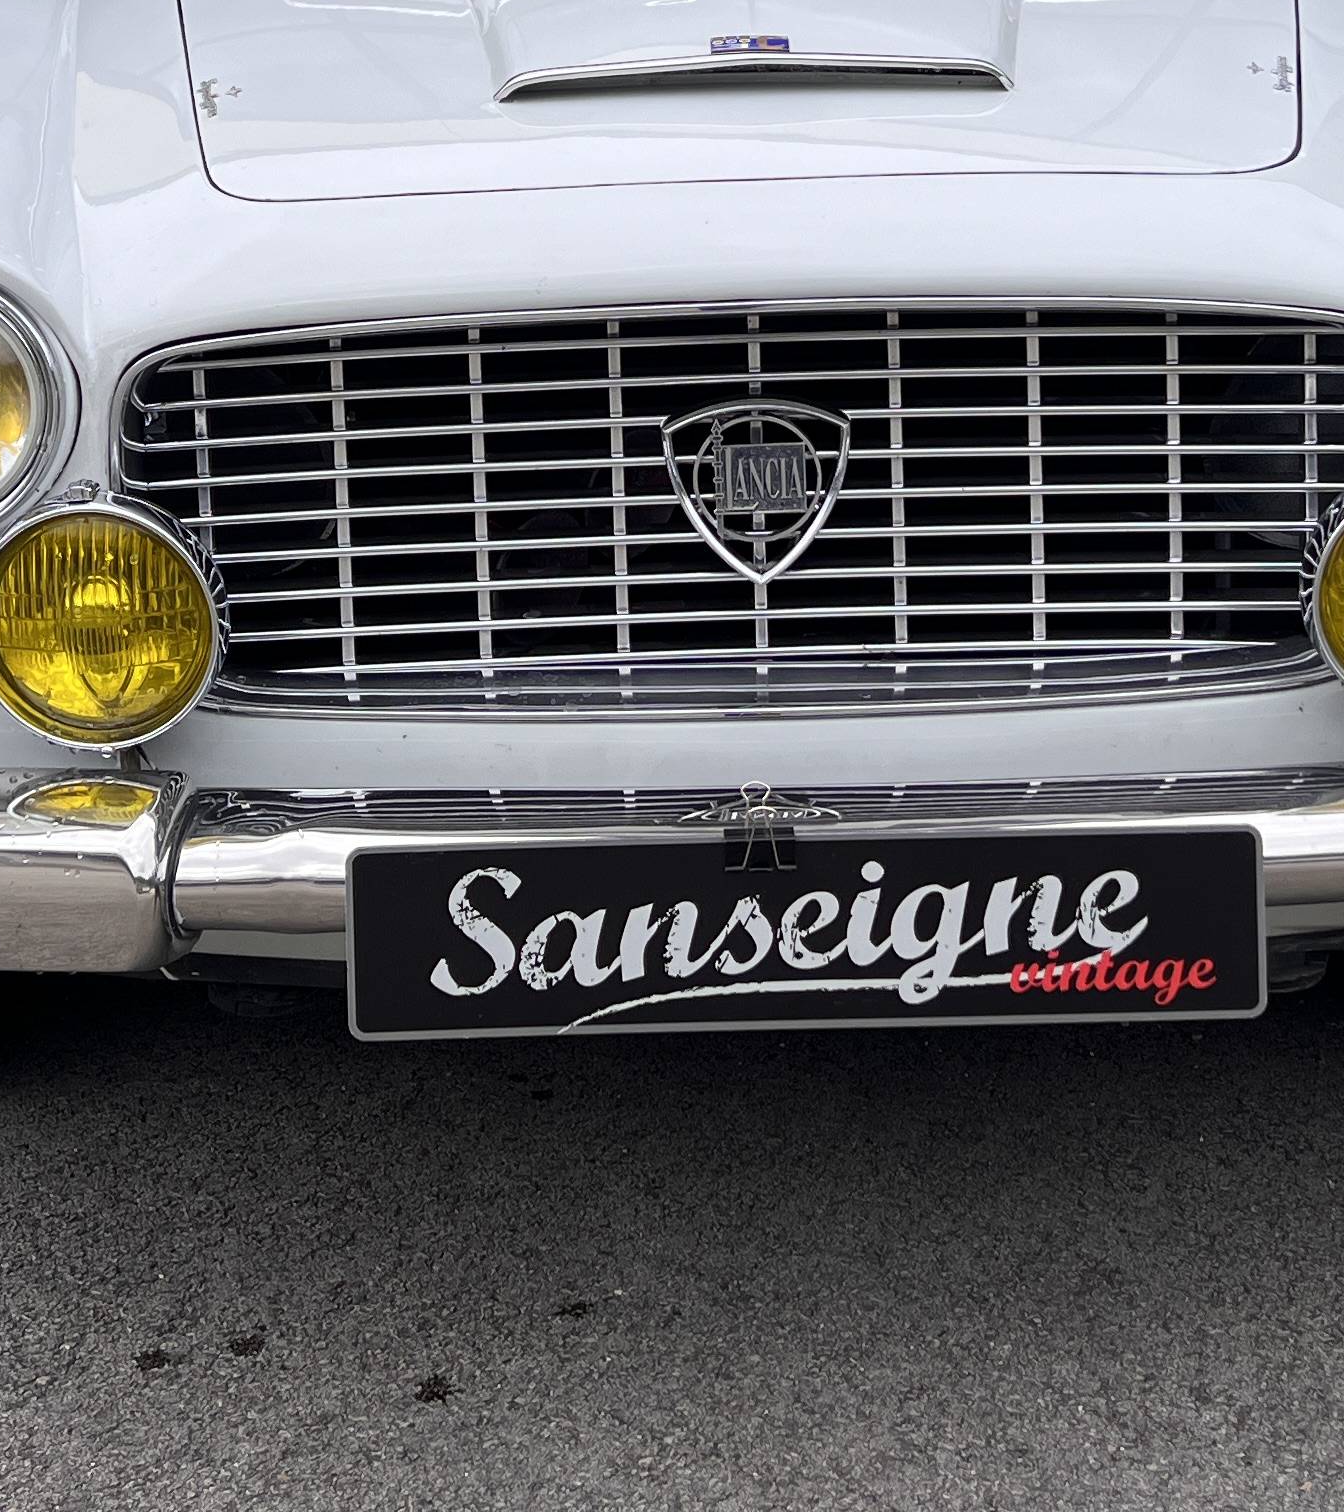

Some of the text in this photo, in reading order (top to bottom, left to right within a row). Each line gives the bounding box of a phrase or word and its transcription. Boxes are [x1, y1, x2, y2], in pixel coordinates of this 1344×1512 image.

[722, 445, 804, 511] LANCIA
[429, 860, 1149, 1005] Sanseigne
[1008, 948, 1219, 1005] vintage
